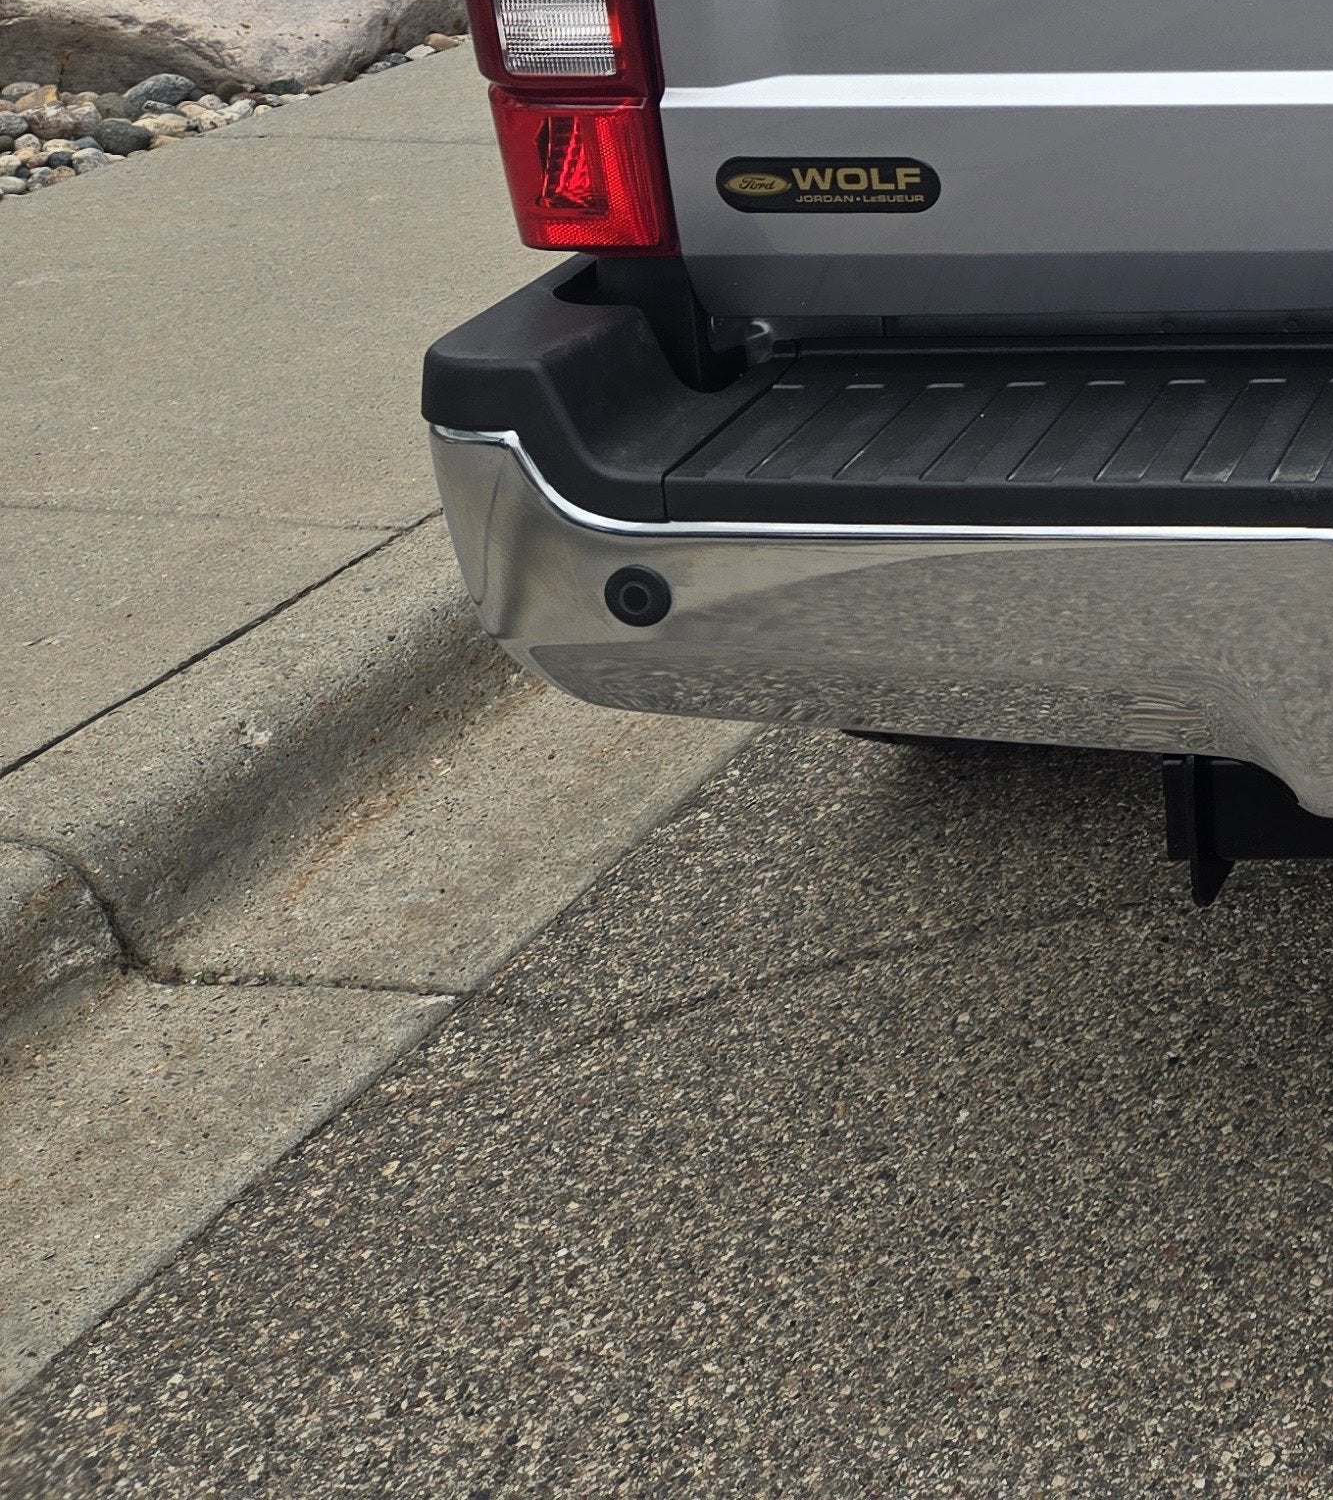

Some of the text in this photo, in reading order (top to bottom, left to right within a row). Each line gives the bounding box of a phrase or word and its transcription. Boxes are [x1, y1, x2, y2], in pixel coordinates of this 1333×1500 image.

[738, 176, 776, 190] Ford
[792, 167, 921, 190] WOLF
[795, 194, 854, 203] JORDAN
